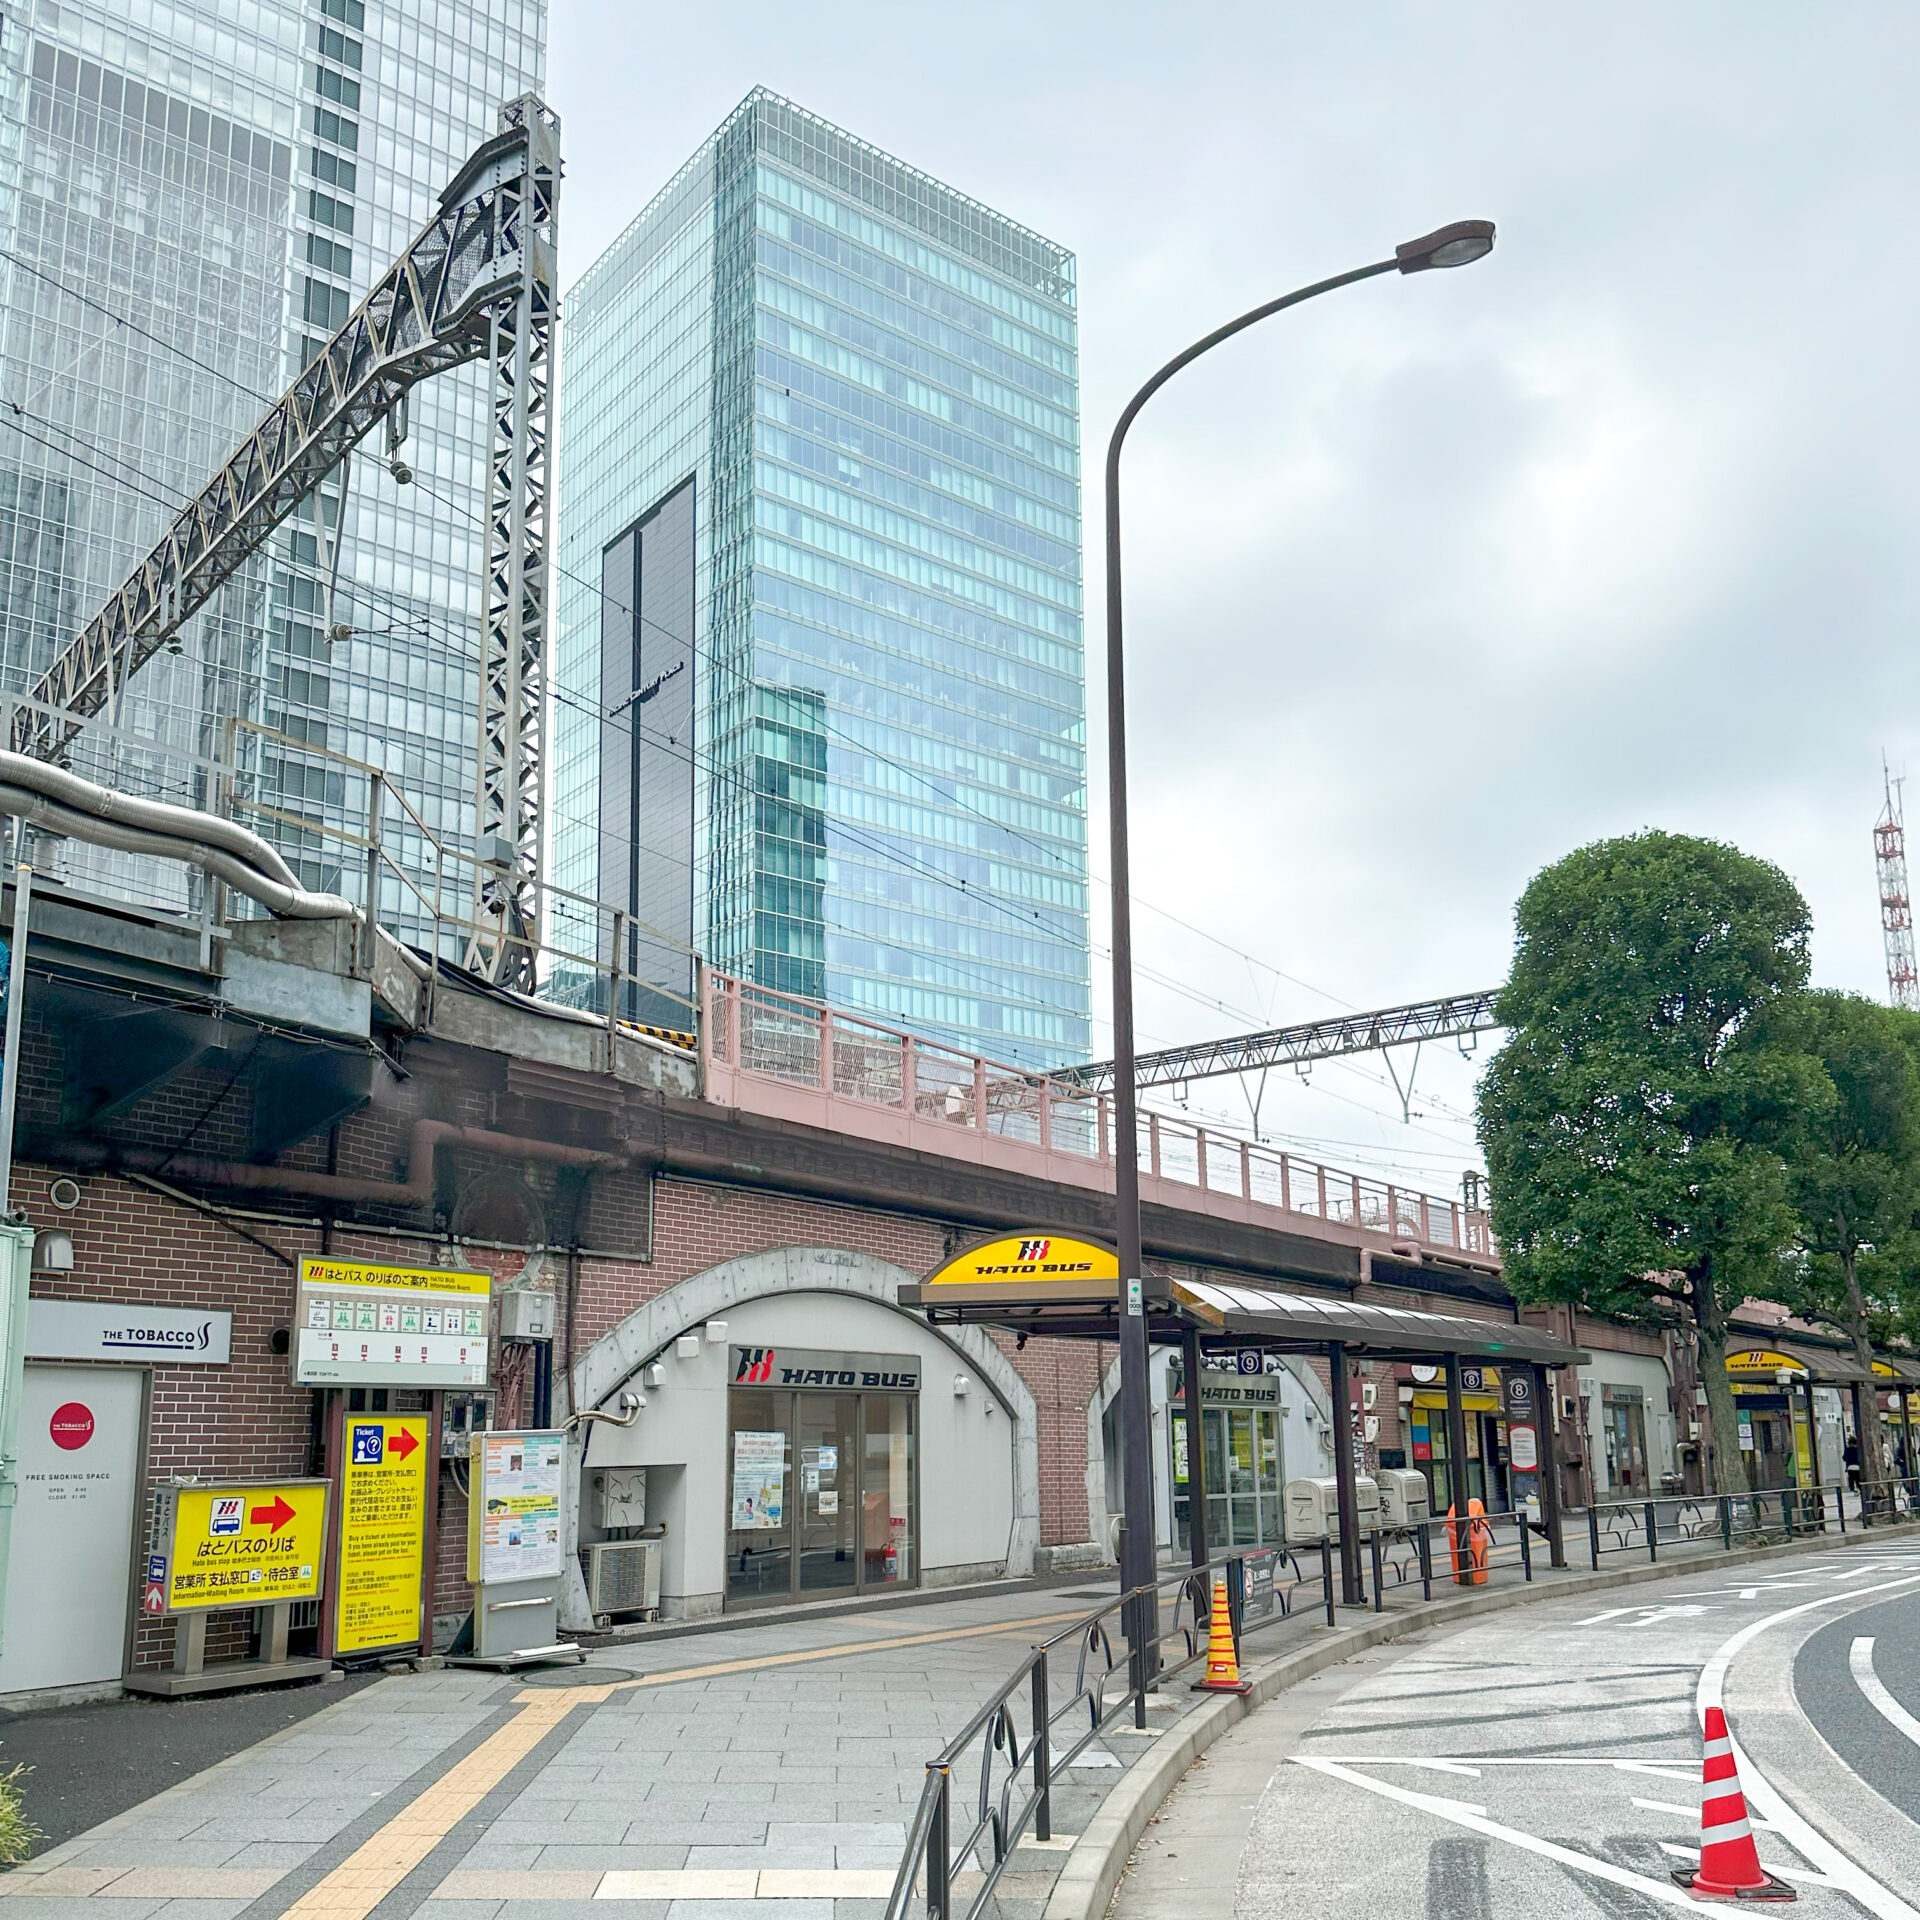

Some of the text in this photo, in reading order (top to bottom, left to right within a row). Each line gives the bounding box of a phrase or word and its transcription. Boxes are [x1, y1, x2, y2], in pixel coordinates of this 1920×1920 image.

[975, 1262, 1093, 1275] HATO BUS
[325, 1268, 428, 1288] はとバス のりばのご案内
[103, 1329, 195, 1343] THE TOBACCO
[1245, 1356, 1254, 1370] 9
[779, 1368, 918, 1387] HATO BUS
[1468, 1375, 1475, 1385] 8
[1201, 1387, 1276, 1401] HATO BUS
[1515, 1384, 1523, 1396] 8
[197, 1536, 296, 1557] はとバスのりば
[218, 1558, 230, 1566] stop
[175, 1572, 206, 1590] 営業所
[209, 1570, 249, 1587] 支払窓口
[228, 1587, 244, 1596] Room
